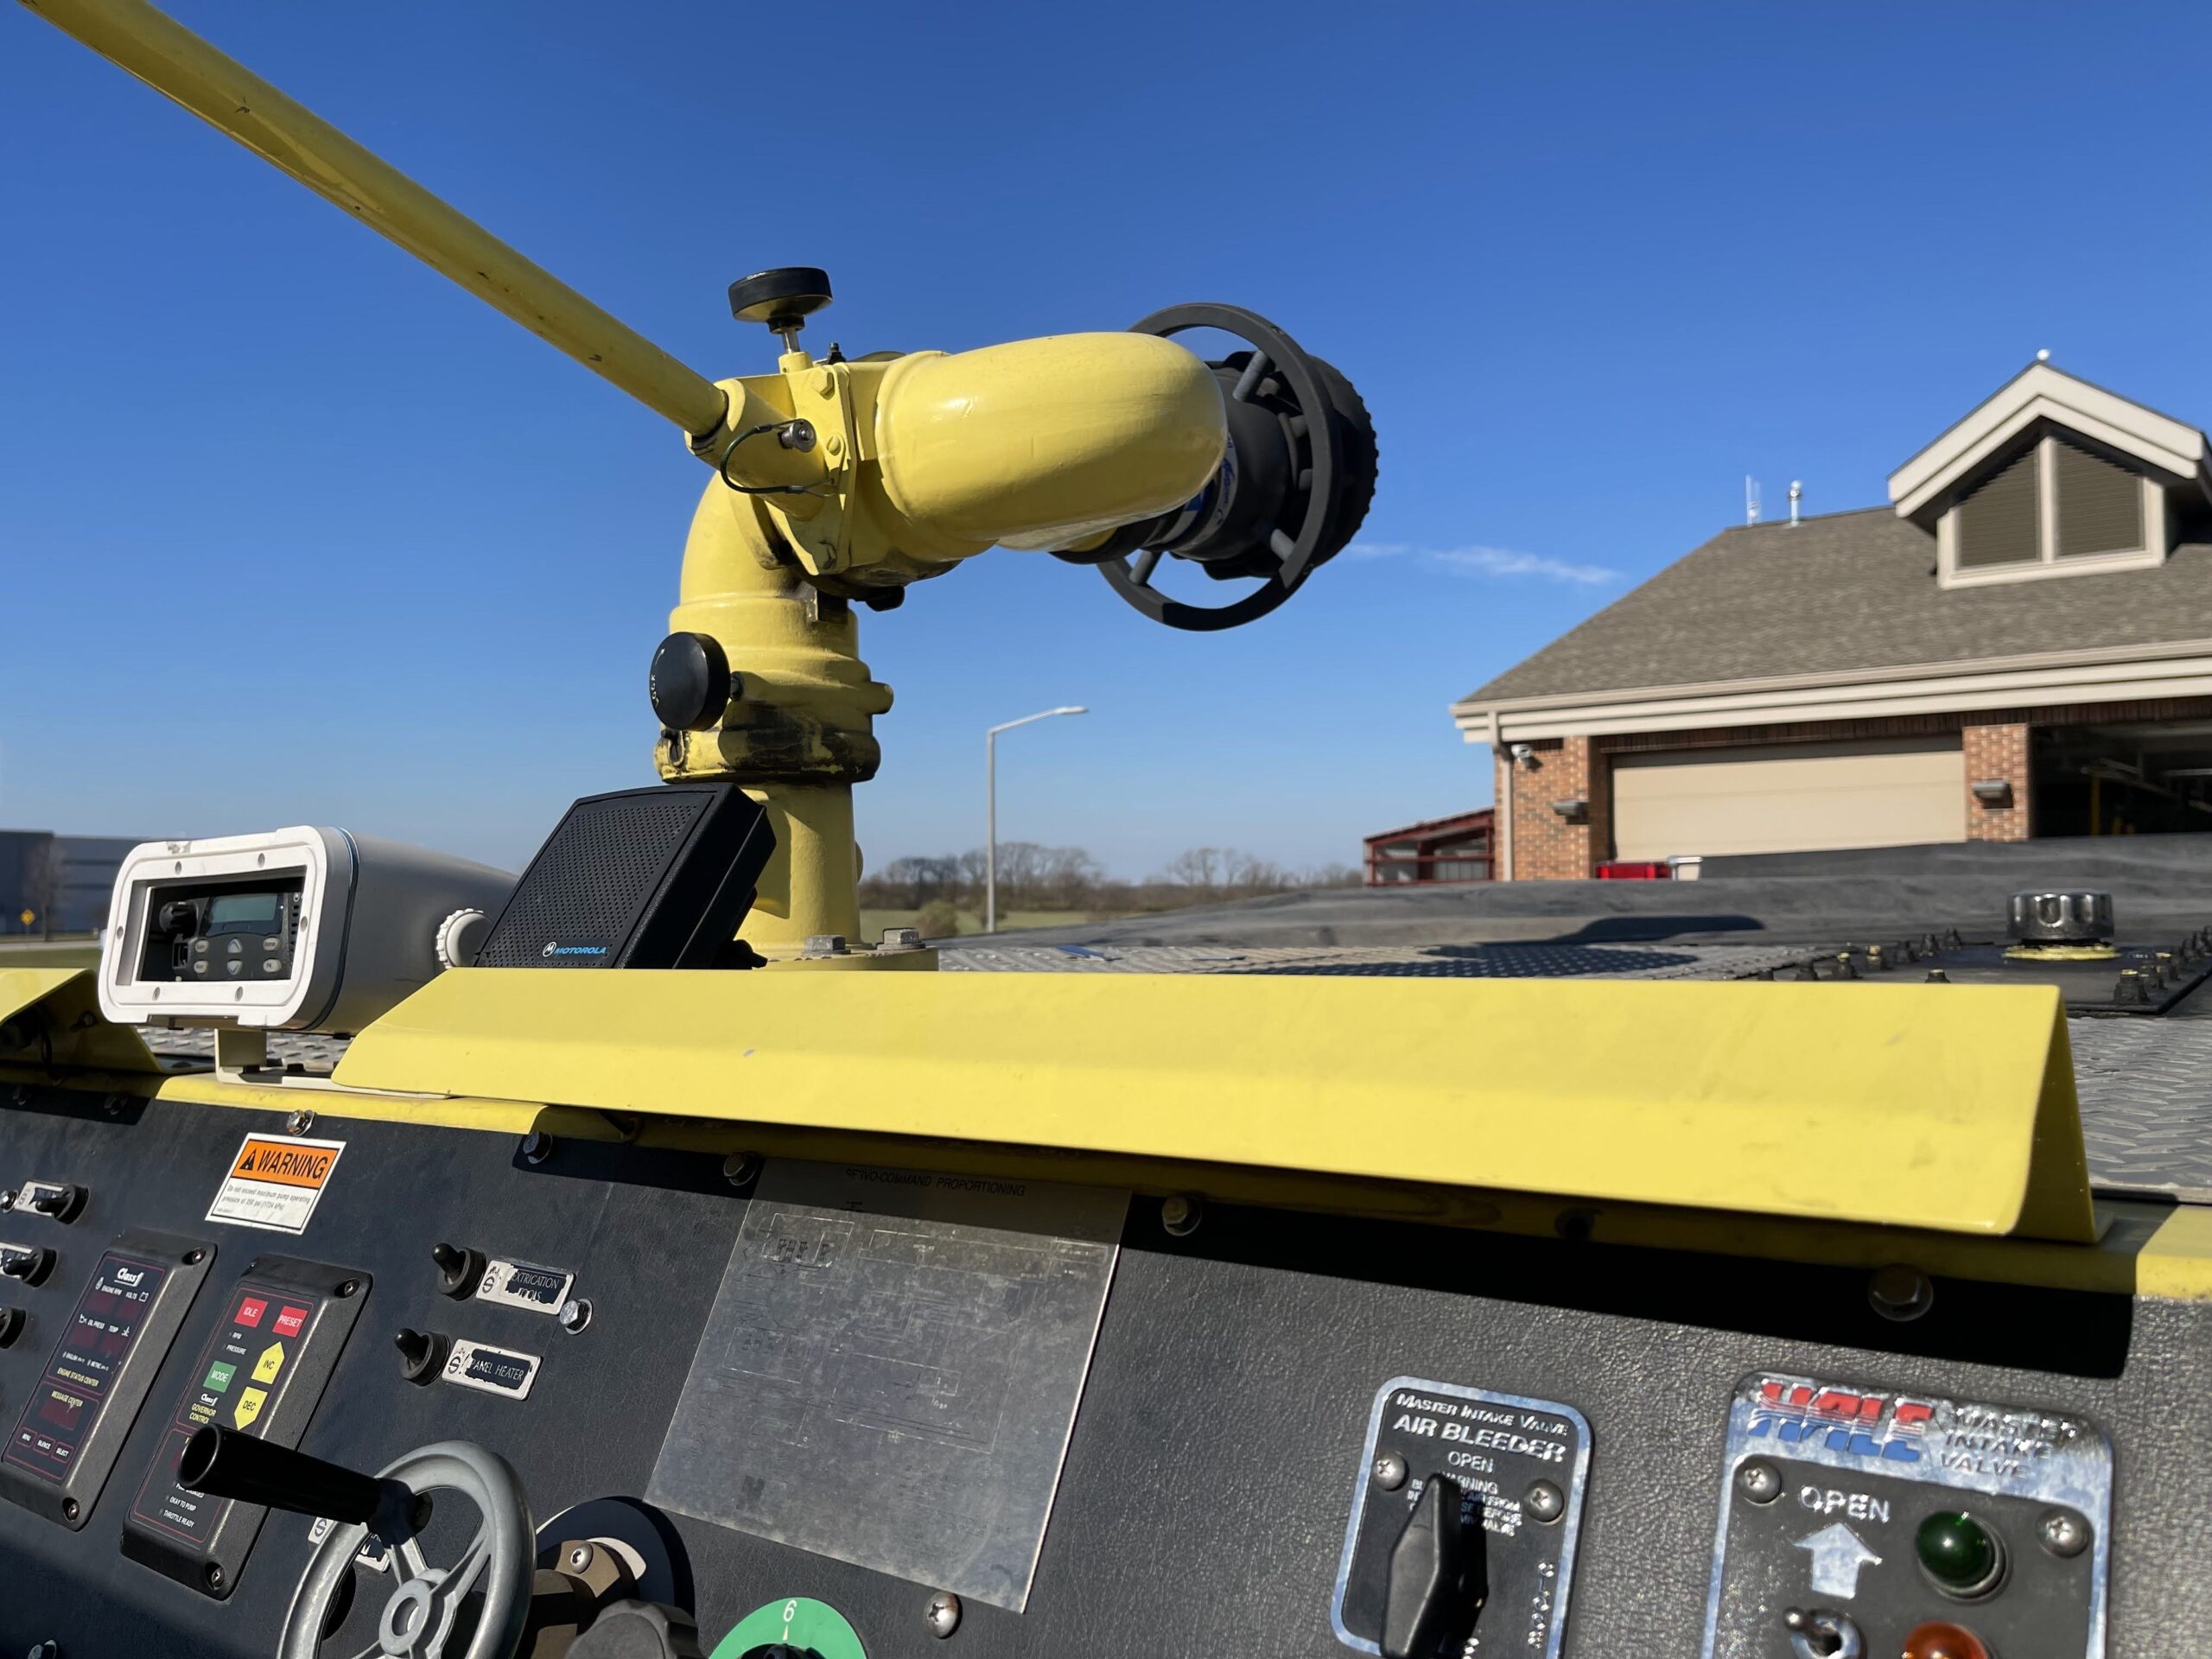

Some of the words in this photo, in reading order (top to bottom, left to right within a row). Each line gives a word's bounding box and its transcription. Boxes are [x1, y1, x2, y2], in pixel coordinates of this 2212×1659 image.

[554, 946, 607, 955] MOTOROLA
[257, 1149, 328, 1179] WARNING
[937, 1176, 1027, 1197] PROPORTIONING
[222, 1196, 240, 1205] pressure
[276, 1192, 289, 1202] pump
[289, 1194, 312, 1205] operating
[512, 1272, 560, 1289] EXTRICATION
[518, 1286, 543, 1301] TOOLS
[243, 1306, 257, 1317] IDLE
[277, 1315, 302, 1327] PRESET
[226, 1344, 246, 1354] PRESSURE
[263, 1359, 274, 1369] INC
[471, 1357, 493, 1374] PANEL
[495, 1363, 524, 1381] HEATER
[211, 1370, 229, 1382] MODE
[191, 1402, 216, 1416] GOVERNOR
[242, 1400, 256, 1410] DEC
[1396, 1392, 1458, 1416] MASTER
[1460, 1404, 1516, 1427] INTAKE
[1392, 1414, 1439, 1438] AIR
[1440, 1422, 1567, 1462] BLEEDER
[1945, 1428, 2054, 1460] INTAKE
[1447, 1450, 1494, 1473] OPEN
[1940, 1452, 2030, 1480] VALVE
[185, 1502, 196, 1510] PUMP
[1799, 1485, 1890, 1524] OPEN
[163, 1510, 181, 1522] THROTTLE
[181, 1516, 194, 1527] READY
[783, 1599, 798, 1622] 6
